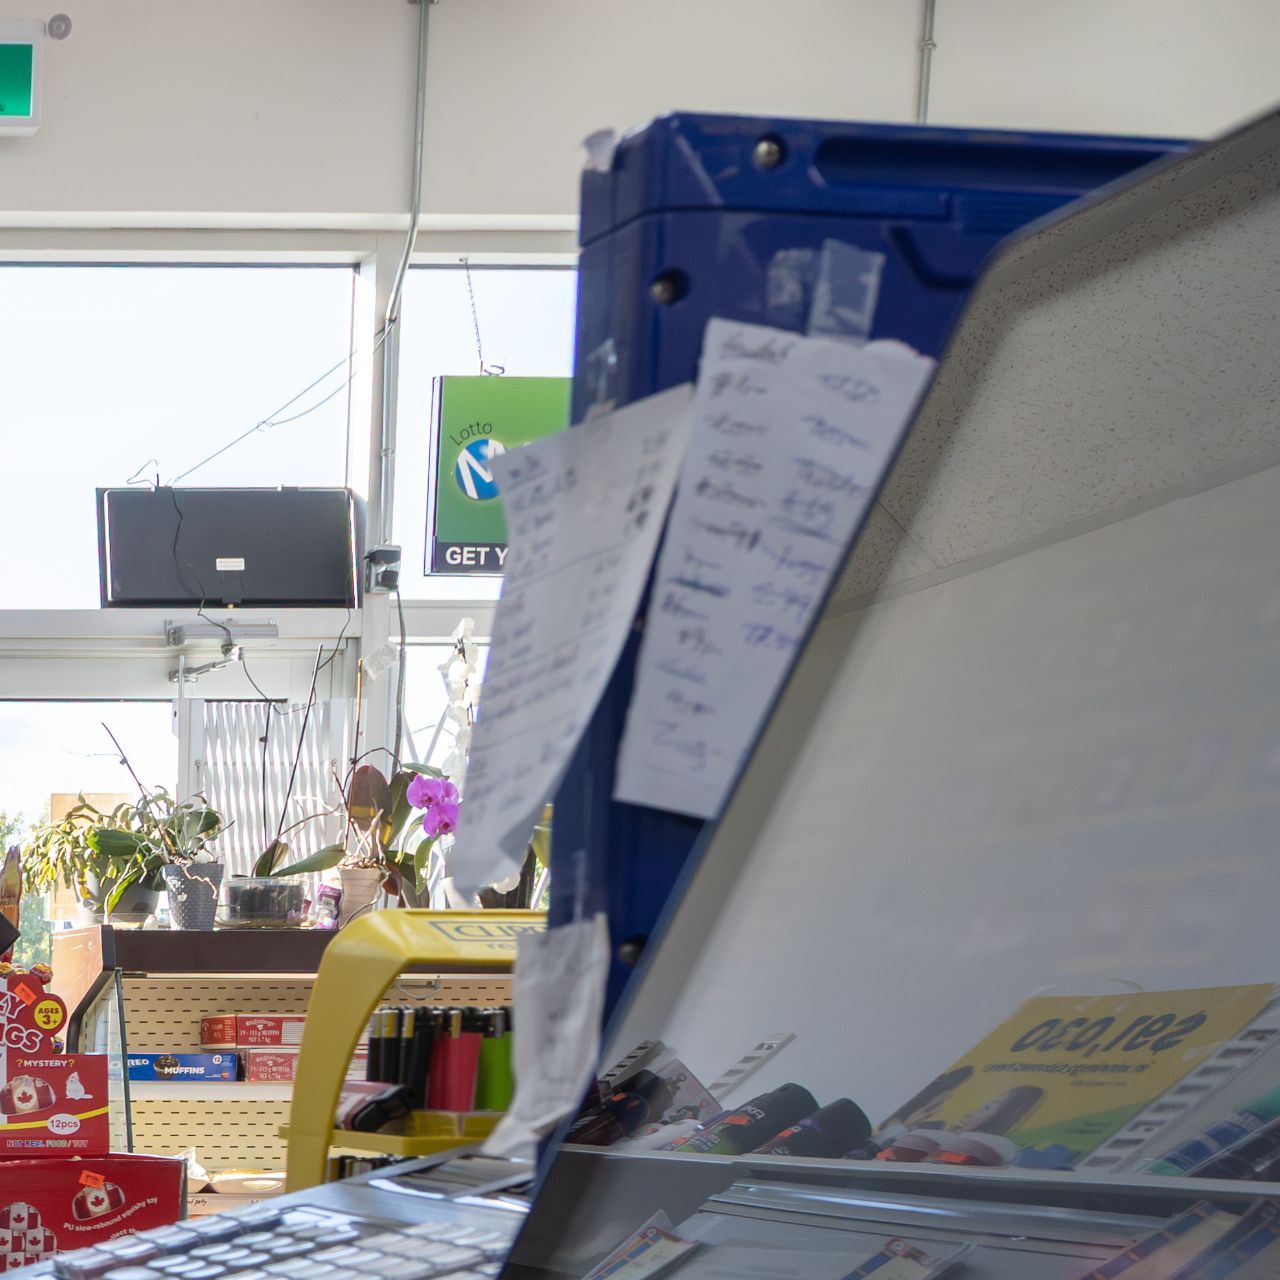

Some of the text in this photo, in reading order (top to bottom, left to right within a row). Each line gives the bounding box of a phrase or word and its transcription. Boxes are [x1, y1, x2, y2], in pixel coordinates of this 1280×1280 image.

[449, 421, 493, 446] Lotto
[445, 546, 490, 565] GET
[38, 1006, 60, 1015] AGES
[42, 1014, 58, 1027] 3+
[164, 1066, 205, 1075] MUFFINS
[50, 1119, 79, 1129] 12pcs
[63, 1222, 74, 1230] PU
[121, 1201, 146, 1218] squishy
